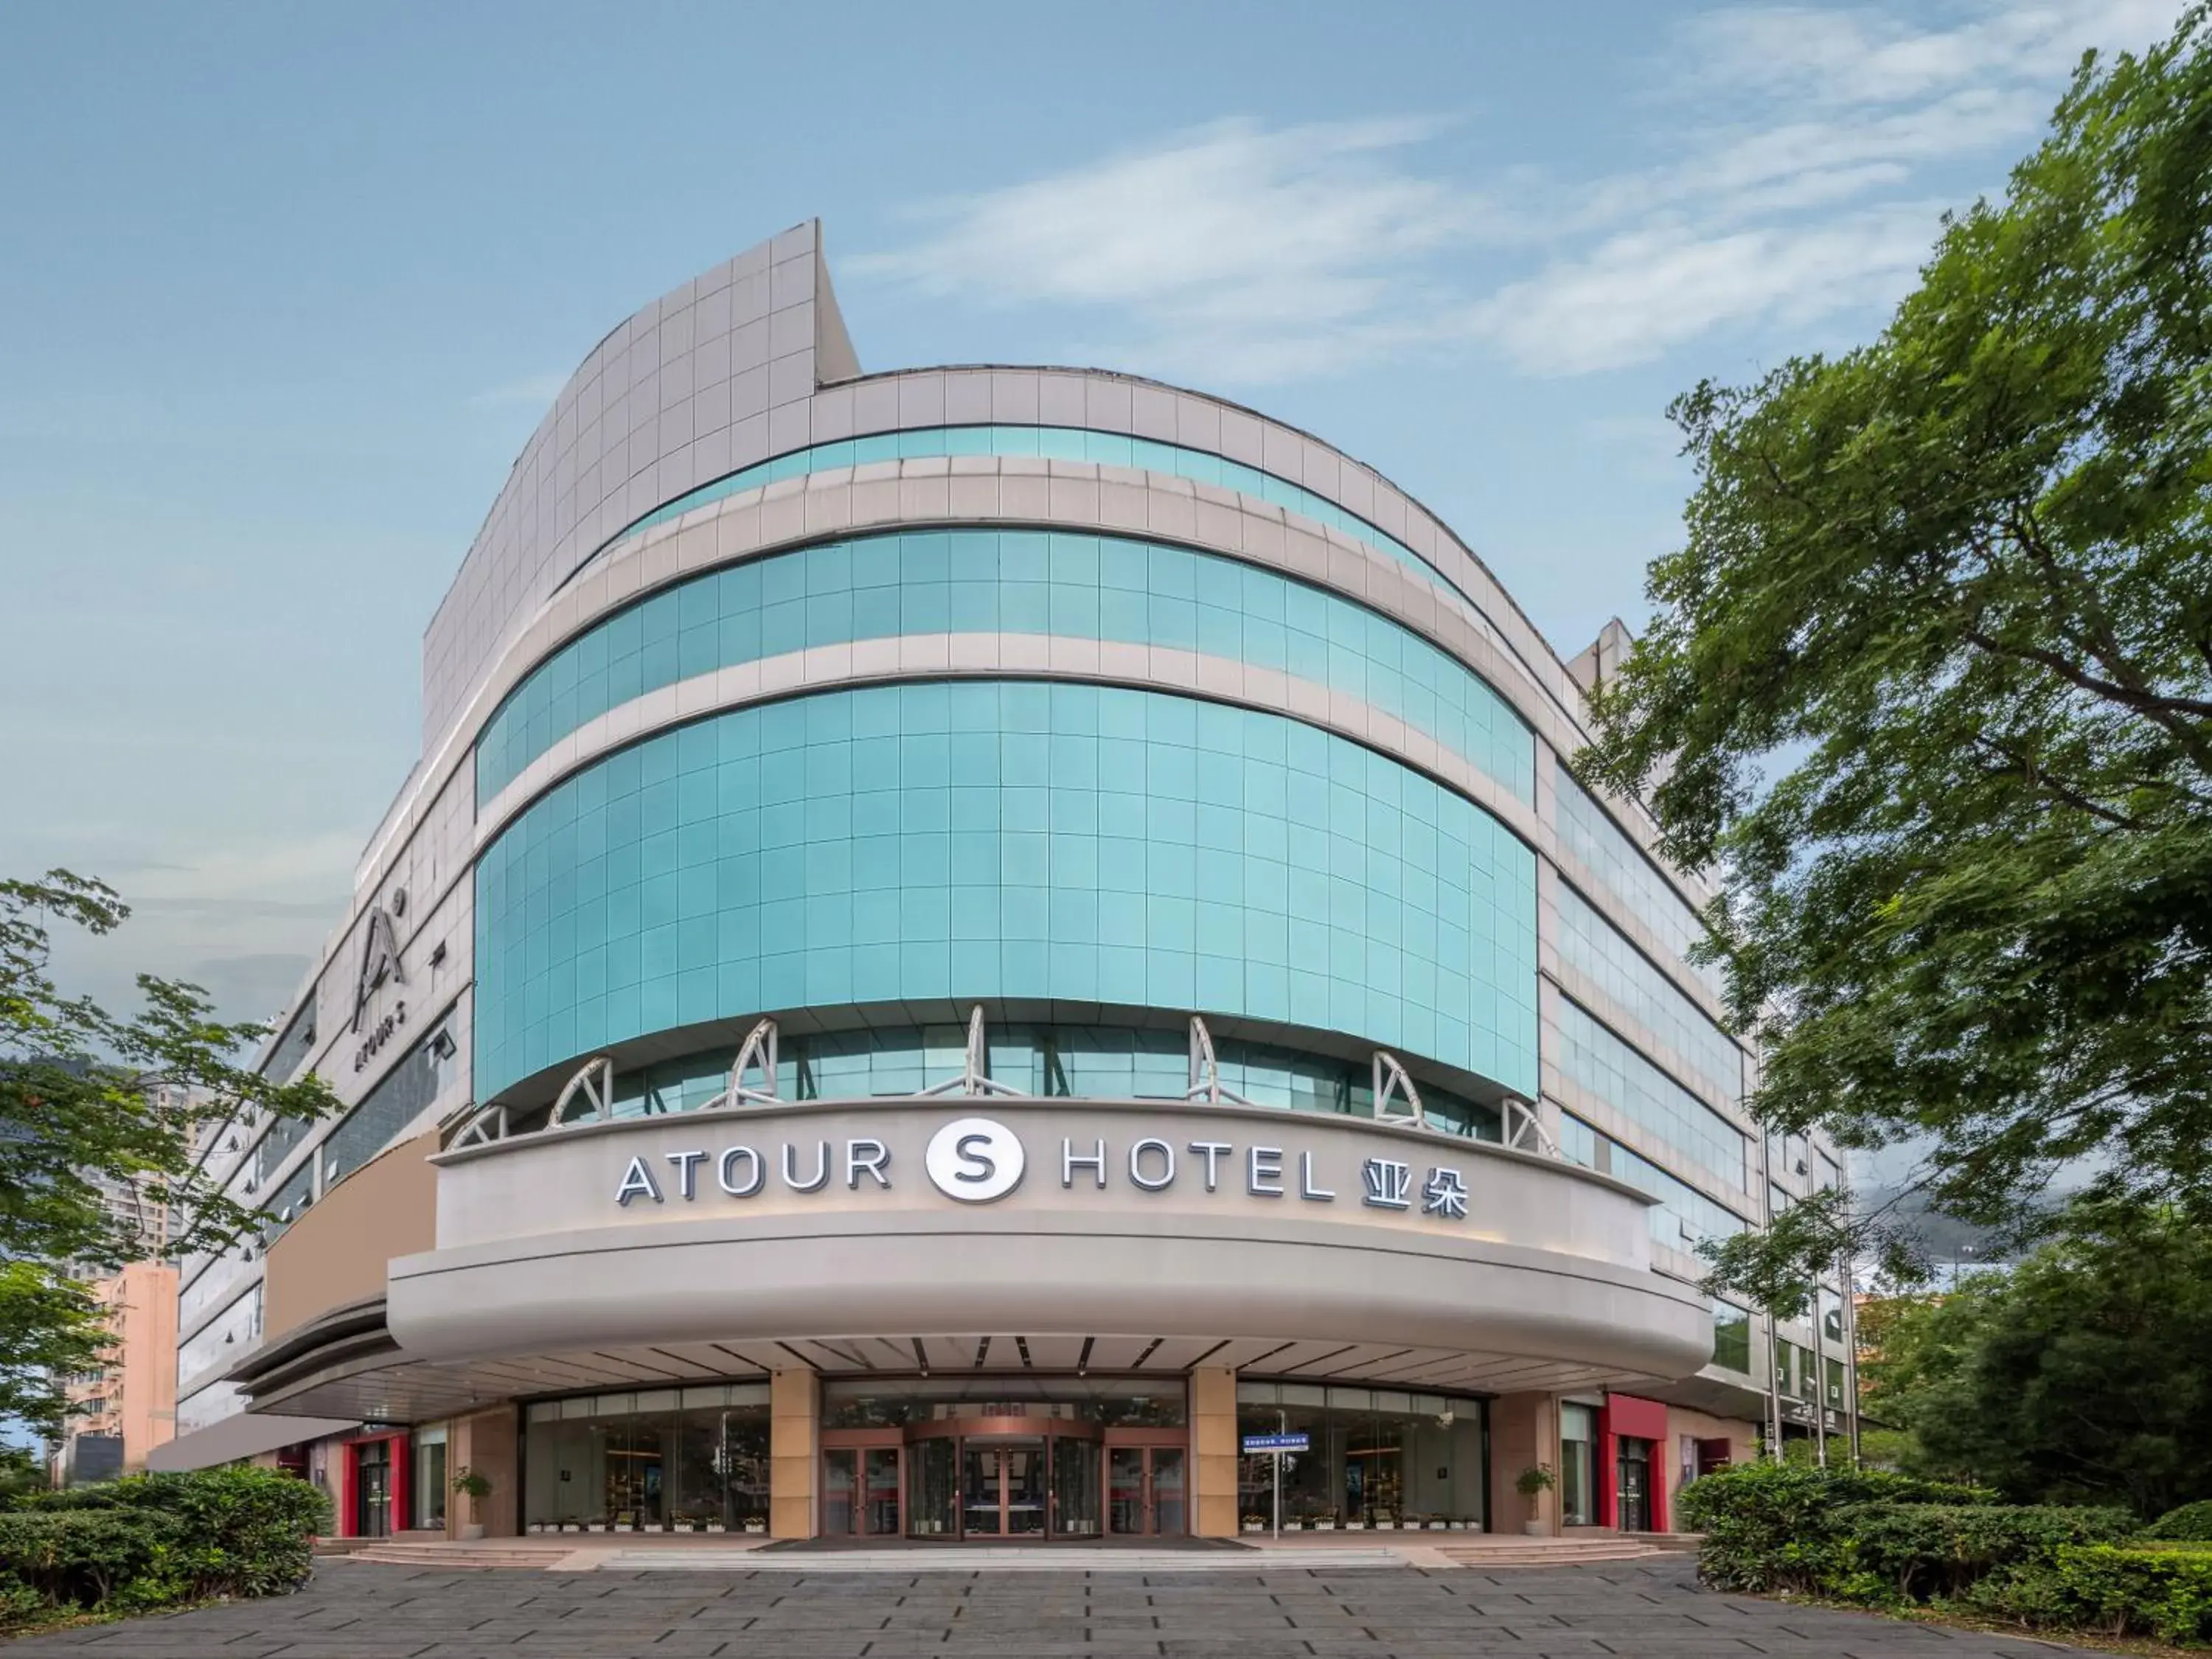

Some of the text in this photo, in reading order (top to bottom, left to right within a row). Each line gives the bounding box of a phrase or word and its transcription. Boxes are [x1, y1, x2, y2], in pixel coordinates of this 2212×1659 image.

[615, 1133, 1336, 1206] ATOUR S HOTEL
[1362, 1157, 1469, 1220] 亚朵
